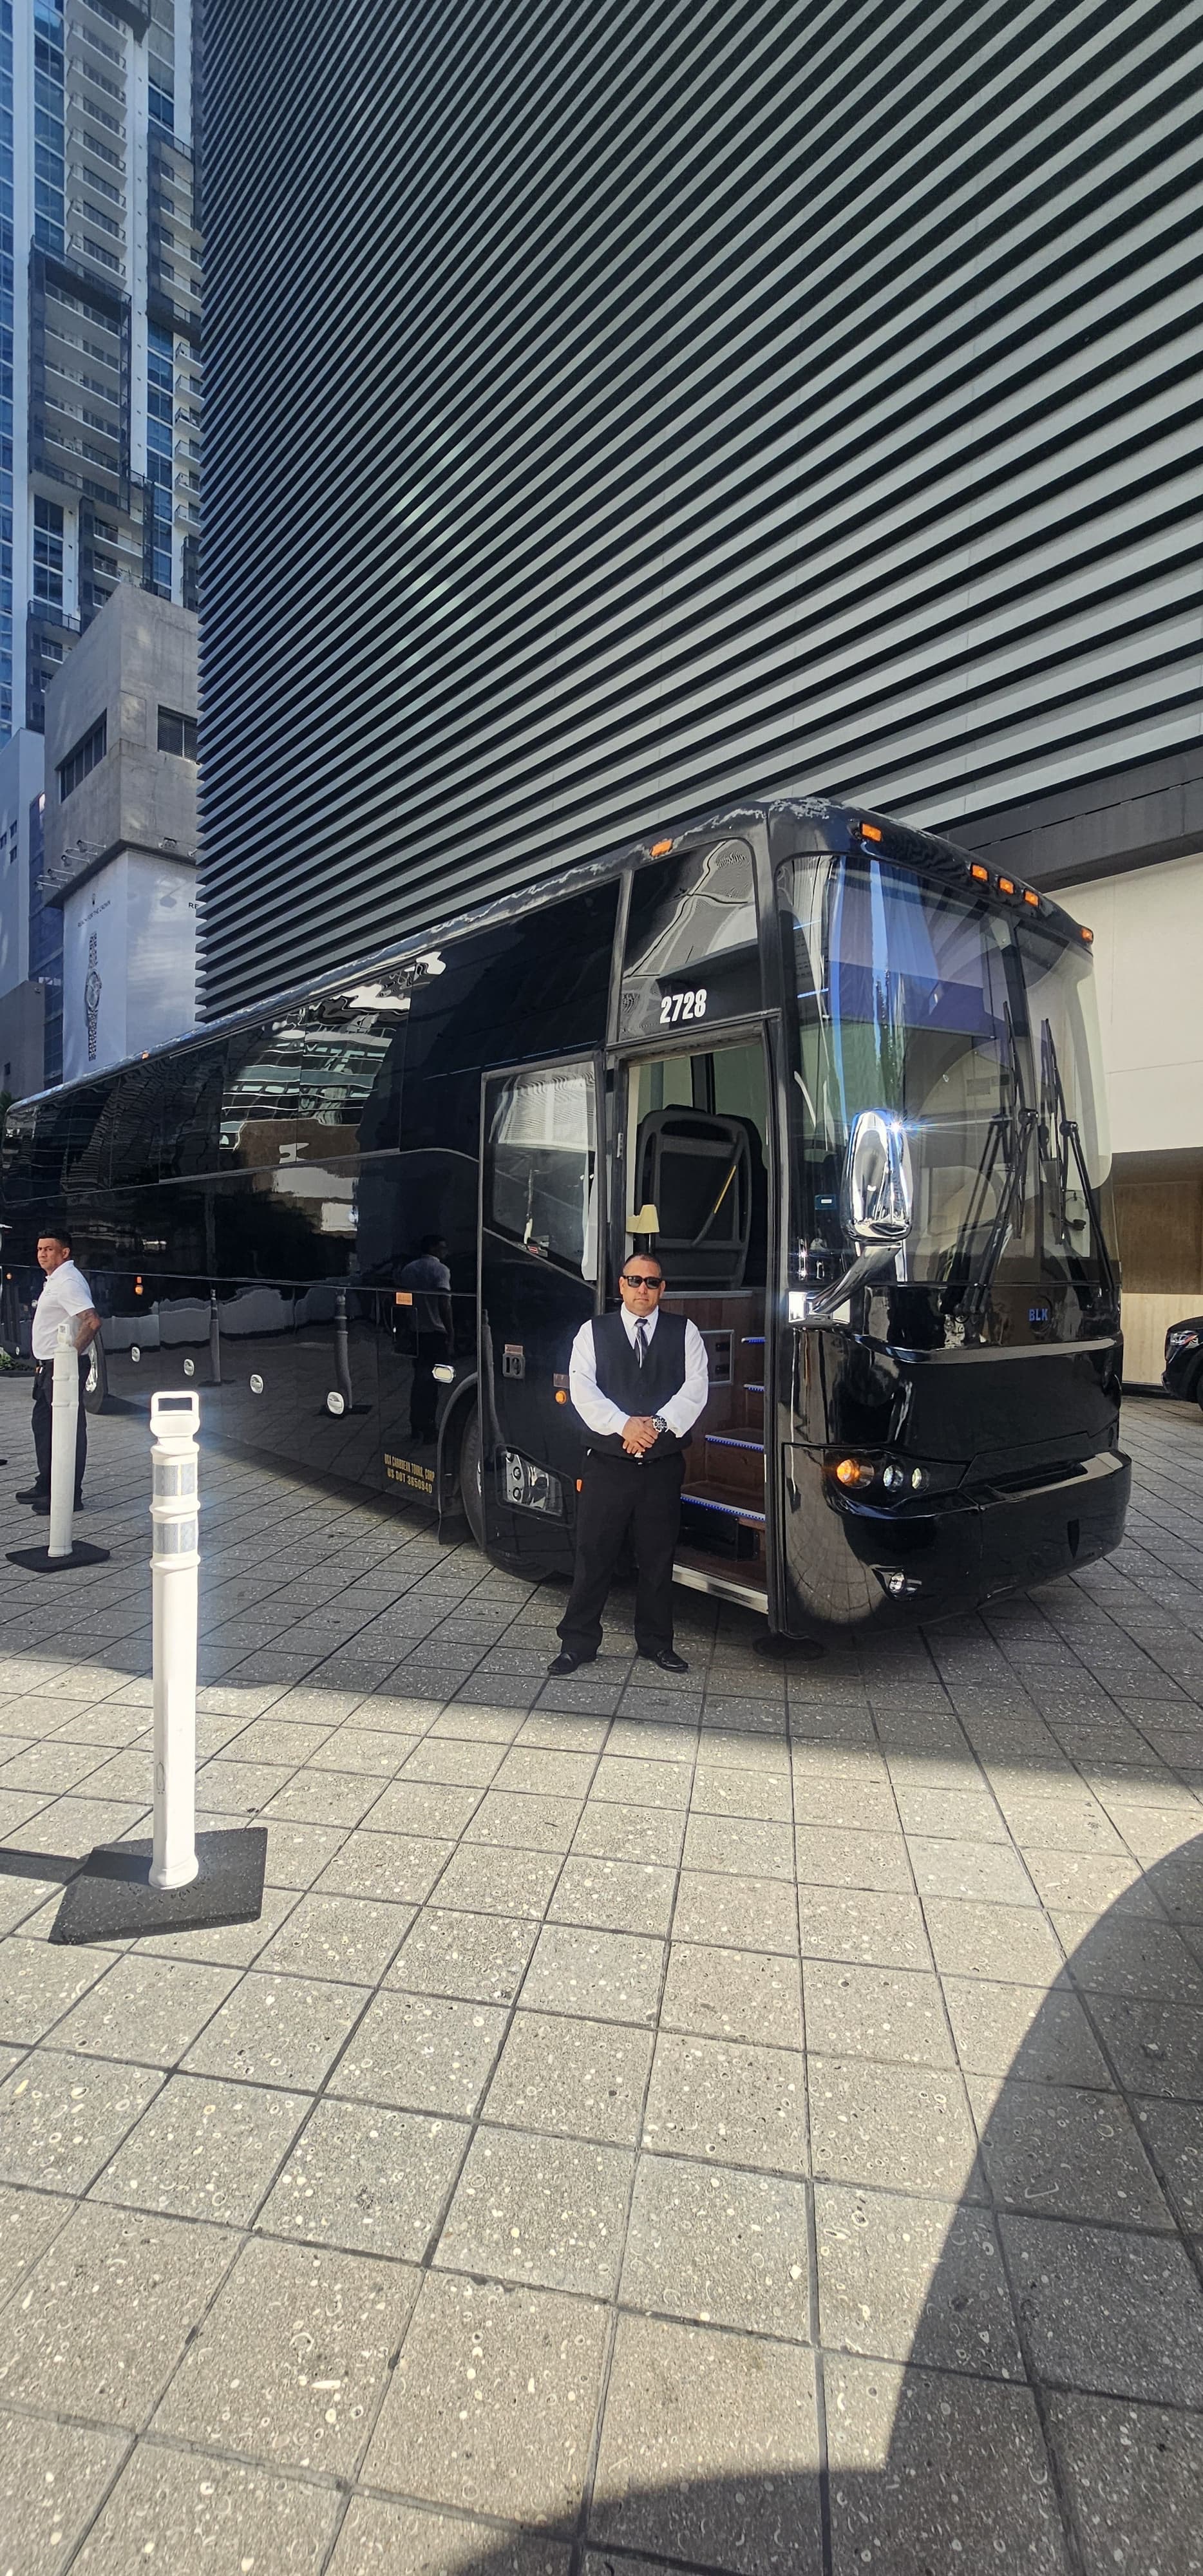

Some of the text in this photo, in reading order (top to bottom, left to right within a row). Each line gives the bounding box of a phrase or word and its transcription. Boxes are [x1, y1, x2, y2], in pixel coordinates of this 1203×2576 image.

[659, 989, 707, 1024] 2728
[1029, 1308, 1048, 1321] BLK
[387, 1468, 395, 1479] US
[395, 1470, 406, 1483] DOT
